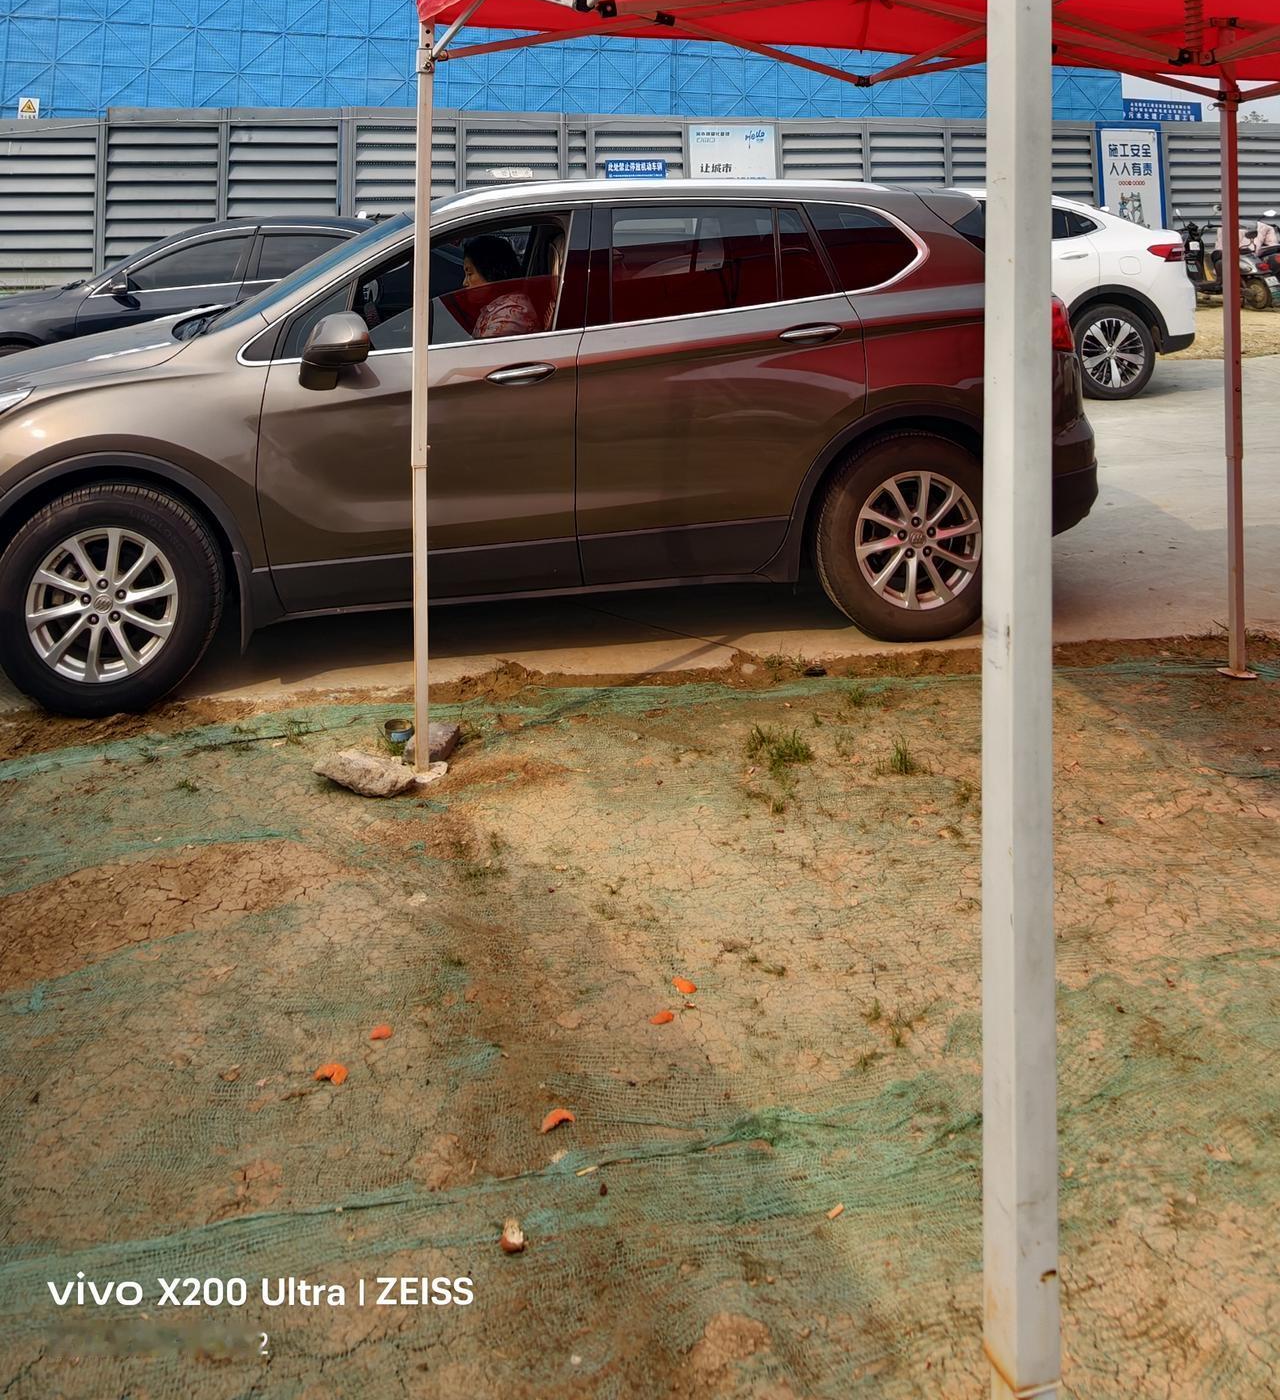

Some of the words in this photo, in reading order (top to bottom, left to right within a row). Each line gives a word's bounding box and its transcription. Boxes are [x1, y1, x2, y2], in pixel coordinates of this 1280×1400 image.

[1108, 143, 1152, 158] 施工安全
[700, 163, 733, 174] 让城市
[1109, 162, 1153, 177] 人人有责
